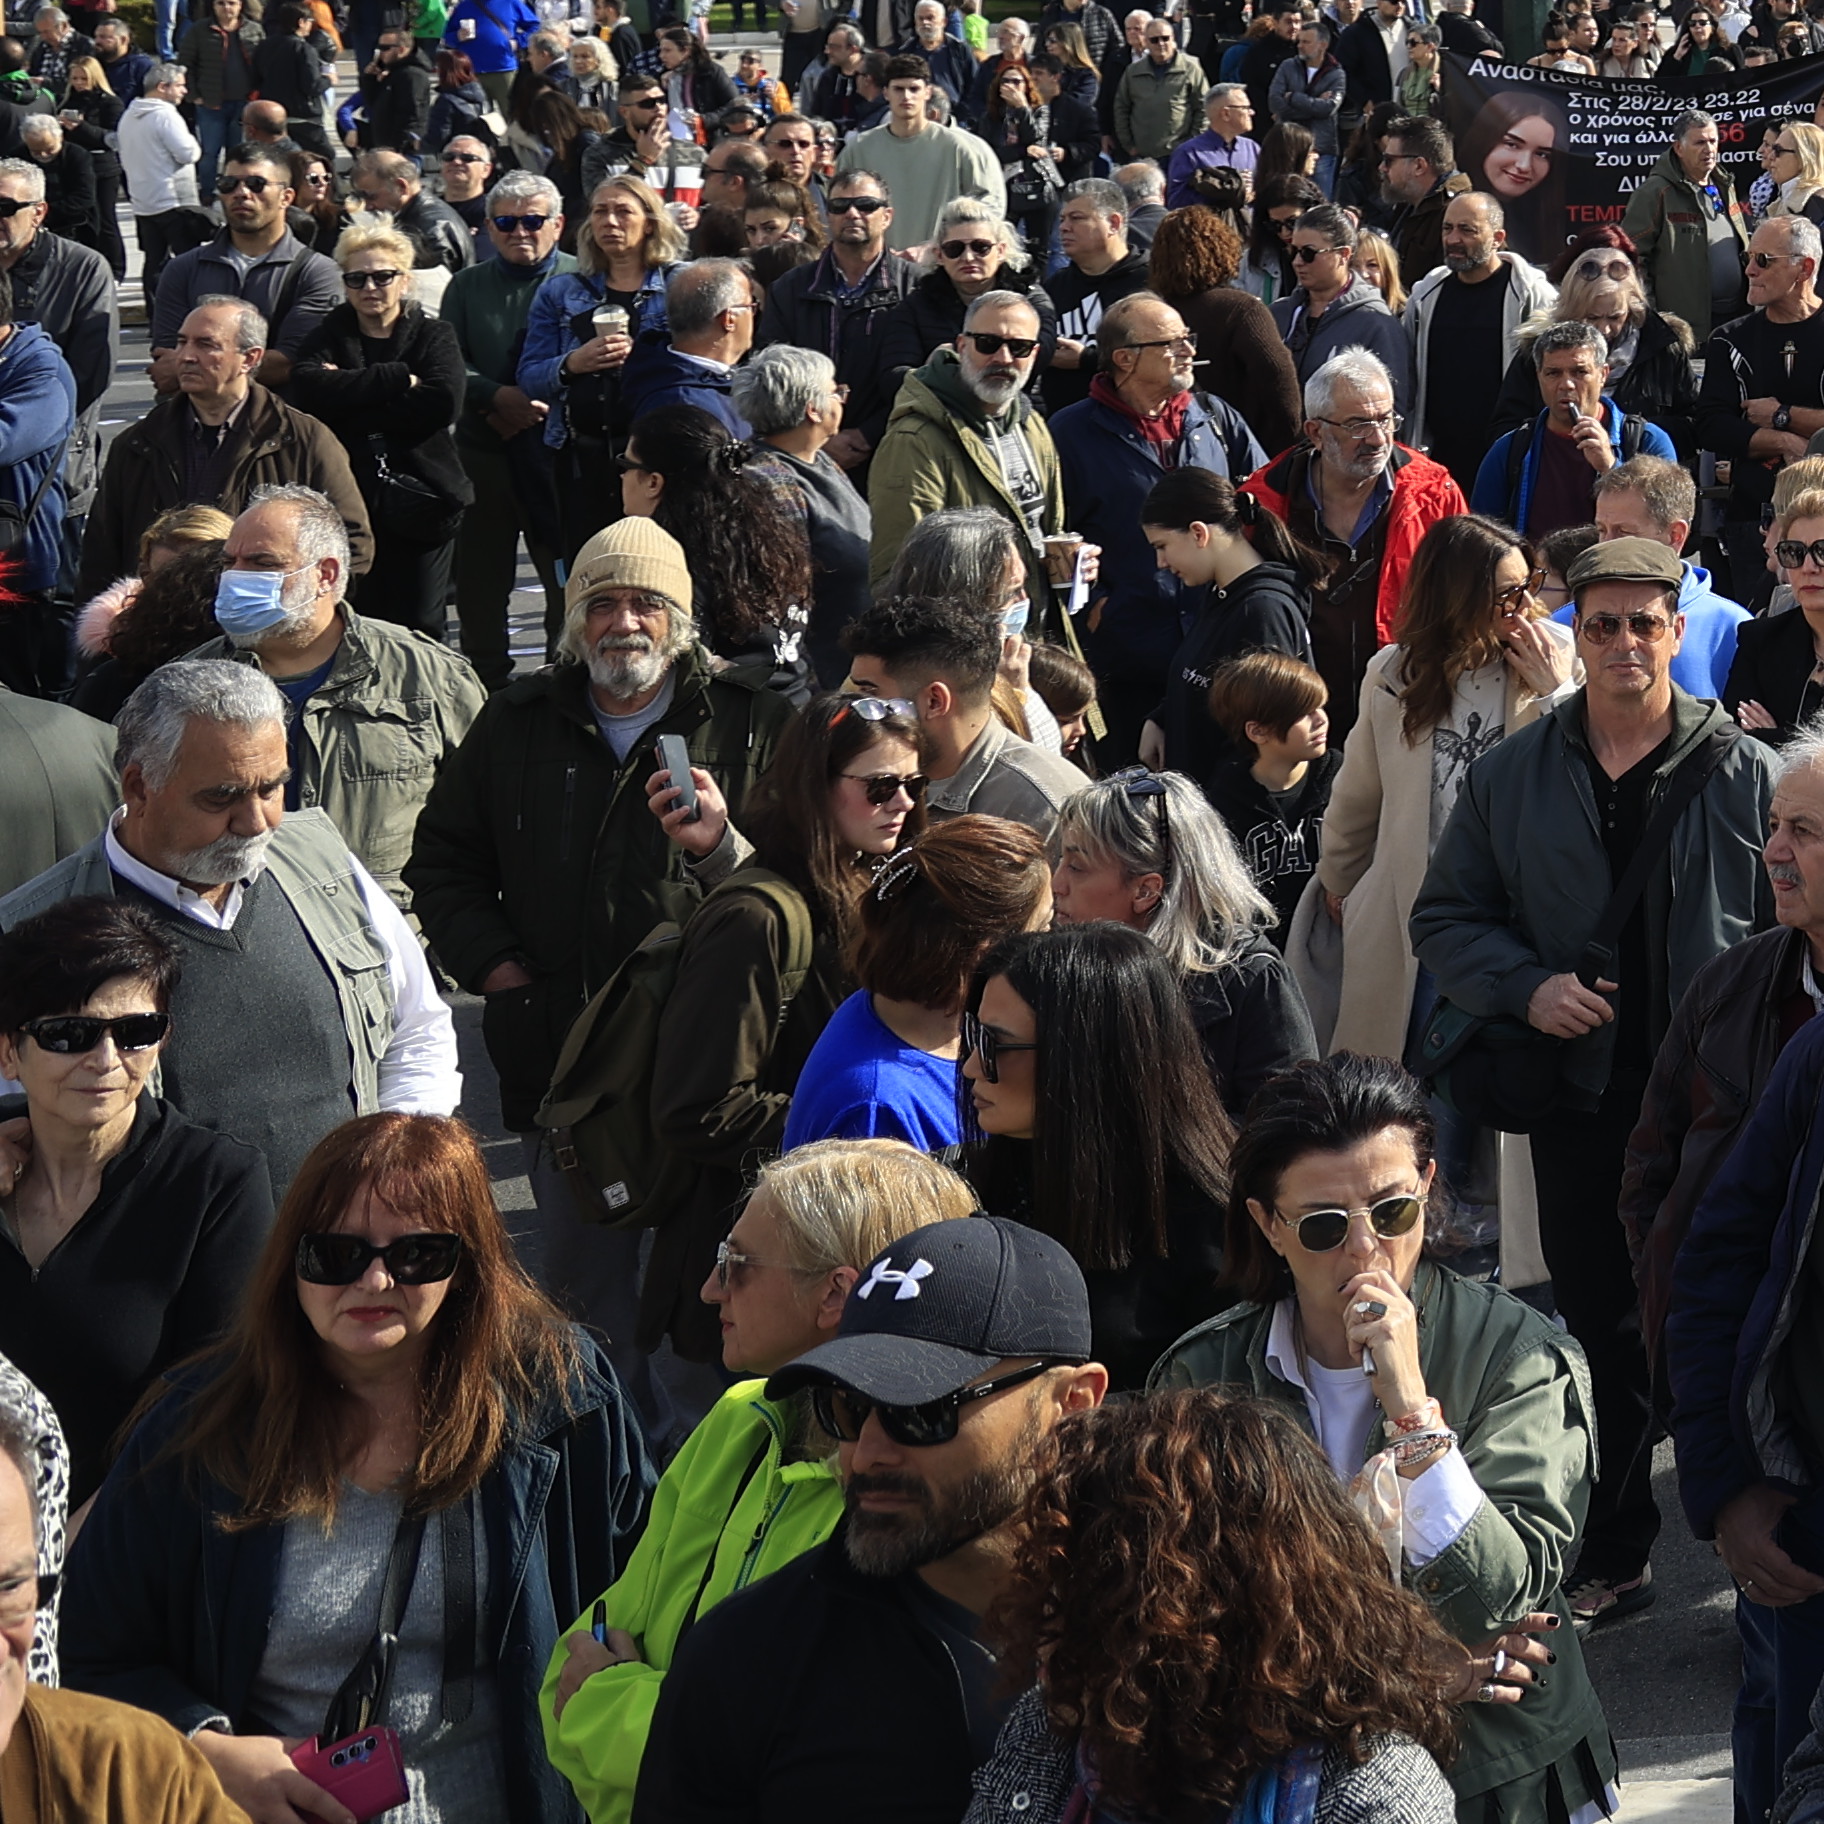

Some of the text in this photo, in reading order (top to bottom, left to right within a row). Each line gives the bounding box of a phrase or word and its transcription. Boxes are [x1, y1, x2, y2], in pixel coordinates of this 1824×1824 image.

[1566, 89, 1760, 112] Στις 28/2/23 23.22
[1569, 114, 1581, 125] ο
[1586, 111, 1656, 128] χρόνος
[1738, 108, 1766, 125] για
[1770, 101, 1816, 119] σένα
[1570, 132, 1598, 144] και
[1604, 132, 1631, 147] για
[1595, 152, 1632, 166] Σου
